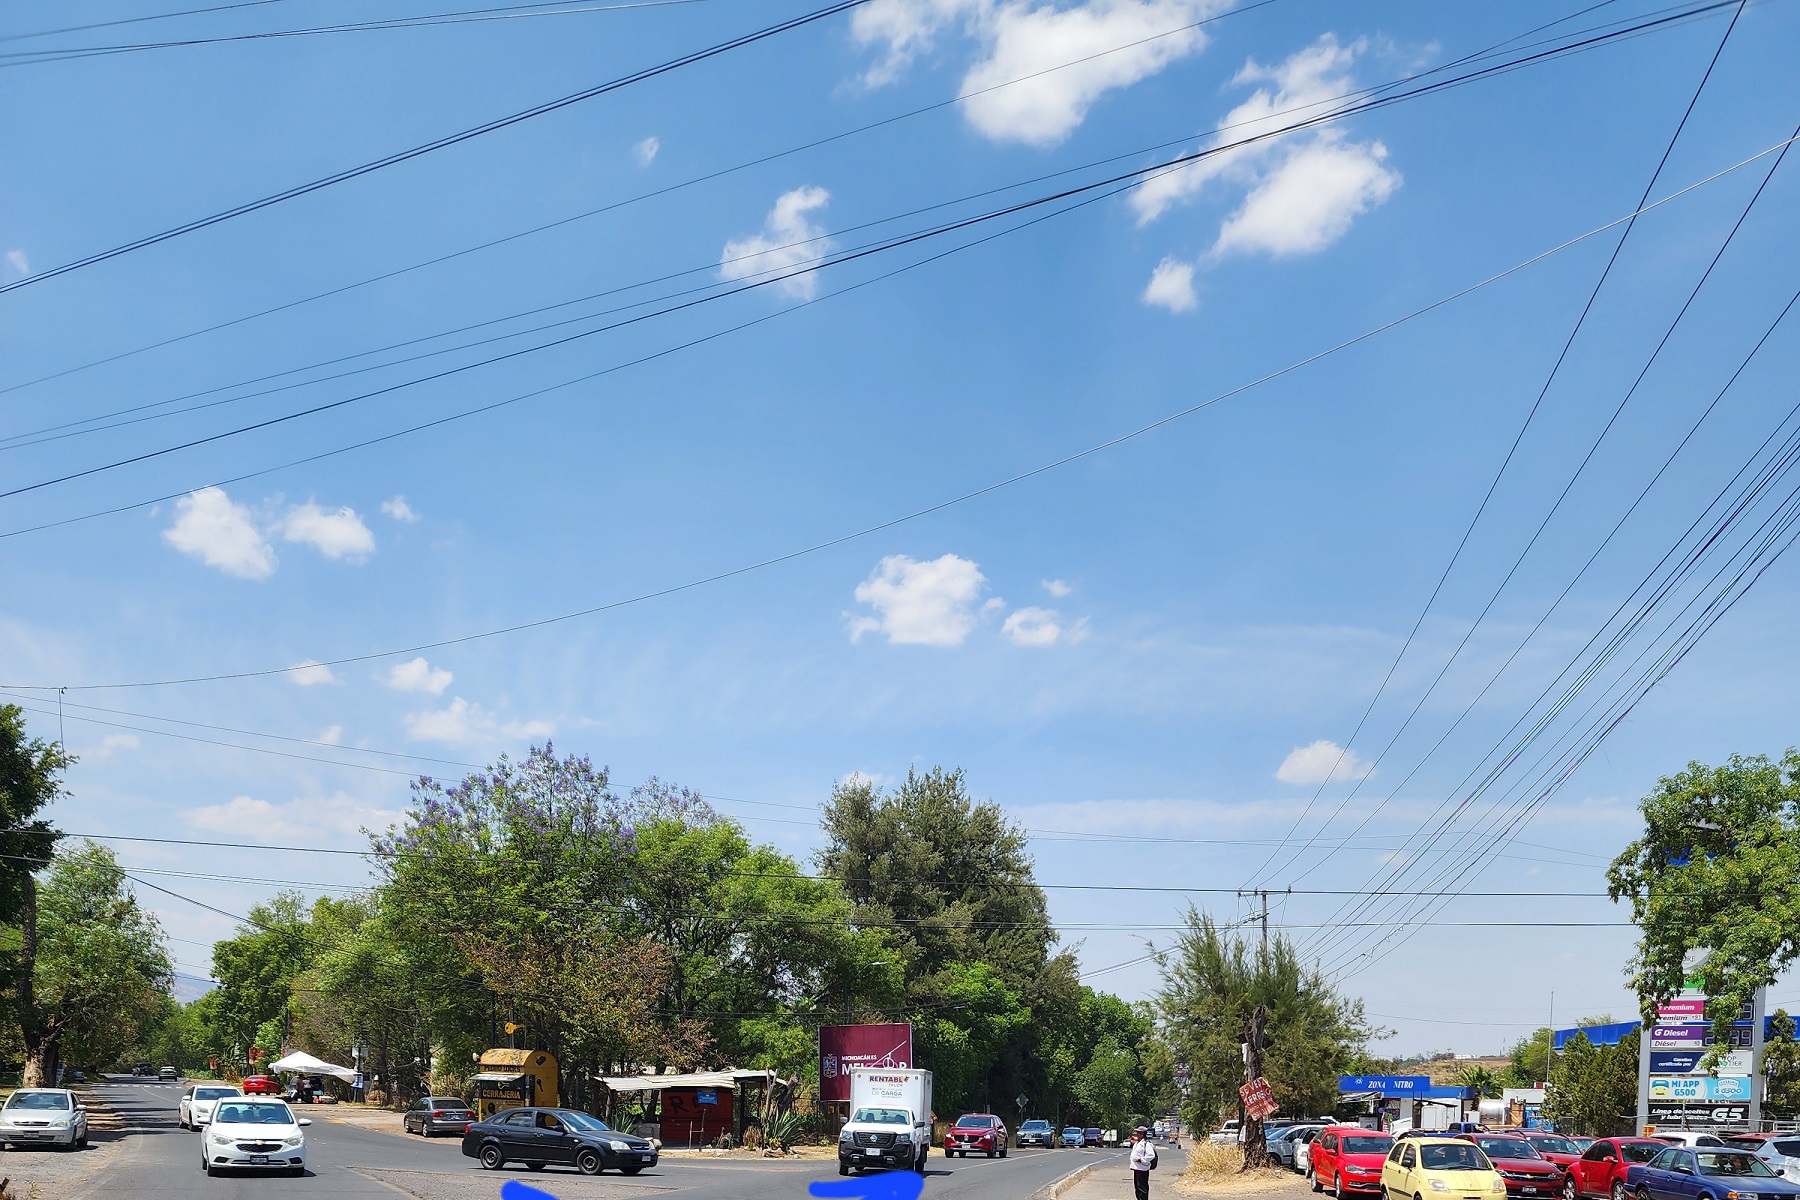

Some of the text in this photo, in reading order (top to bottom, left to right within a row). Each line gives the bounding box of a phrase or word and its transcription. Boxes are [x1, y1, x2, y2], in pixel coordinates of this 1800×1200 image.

[1654, 1028, 1689, 1037] G Diesel
[1367, 1080, 1414, 1089] ZONA NITRO
[1674, 1088, 1696, 1096] G500
